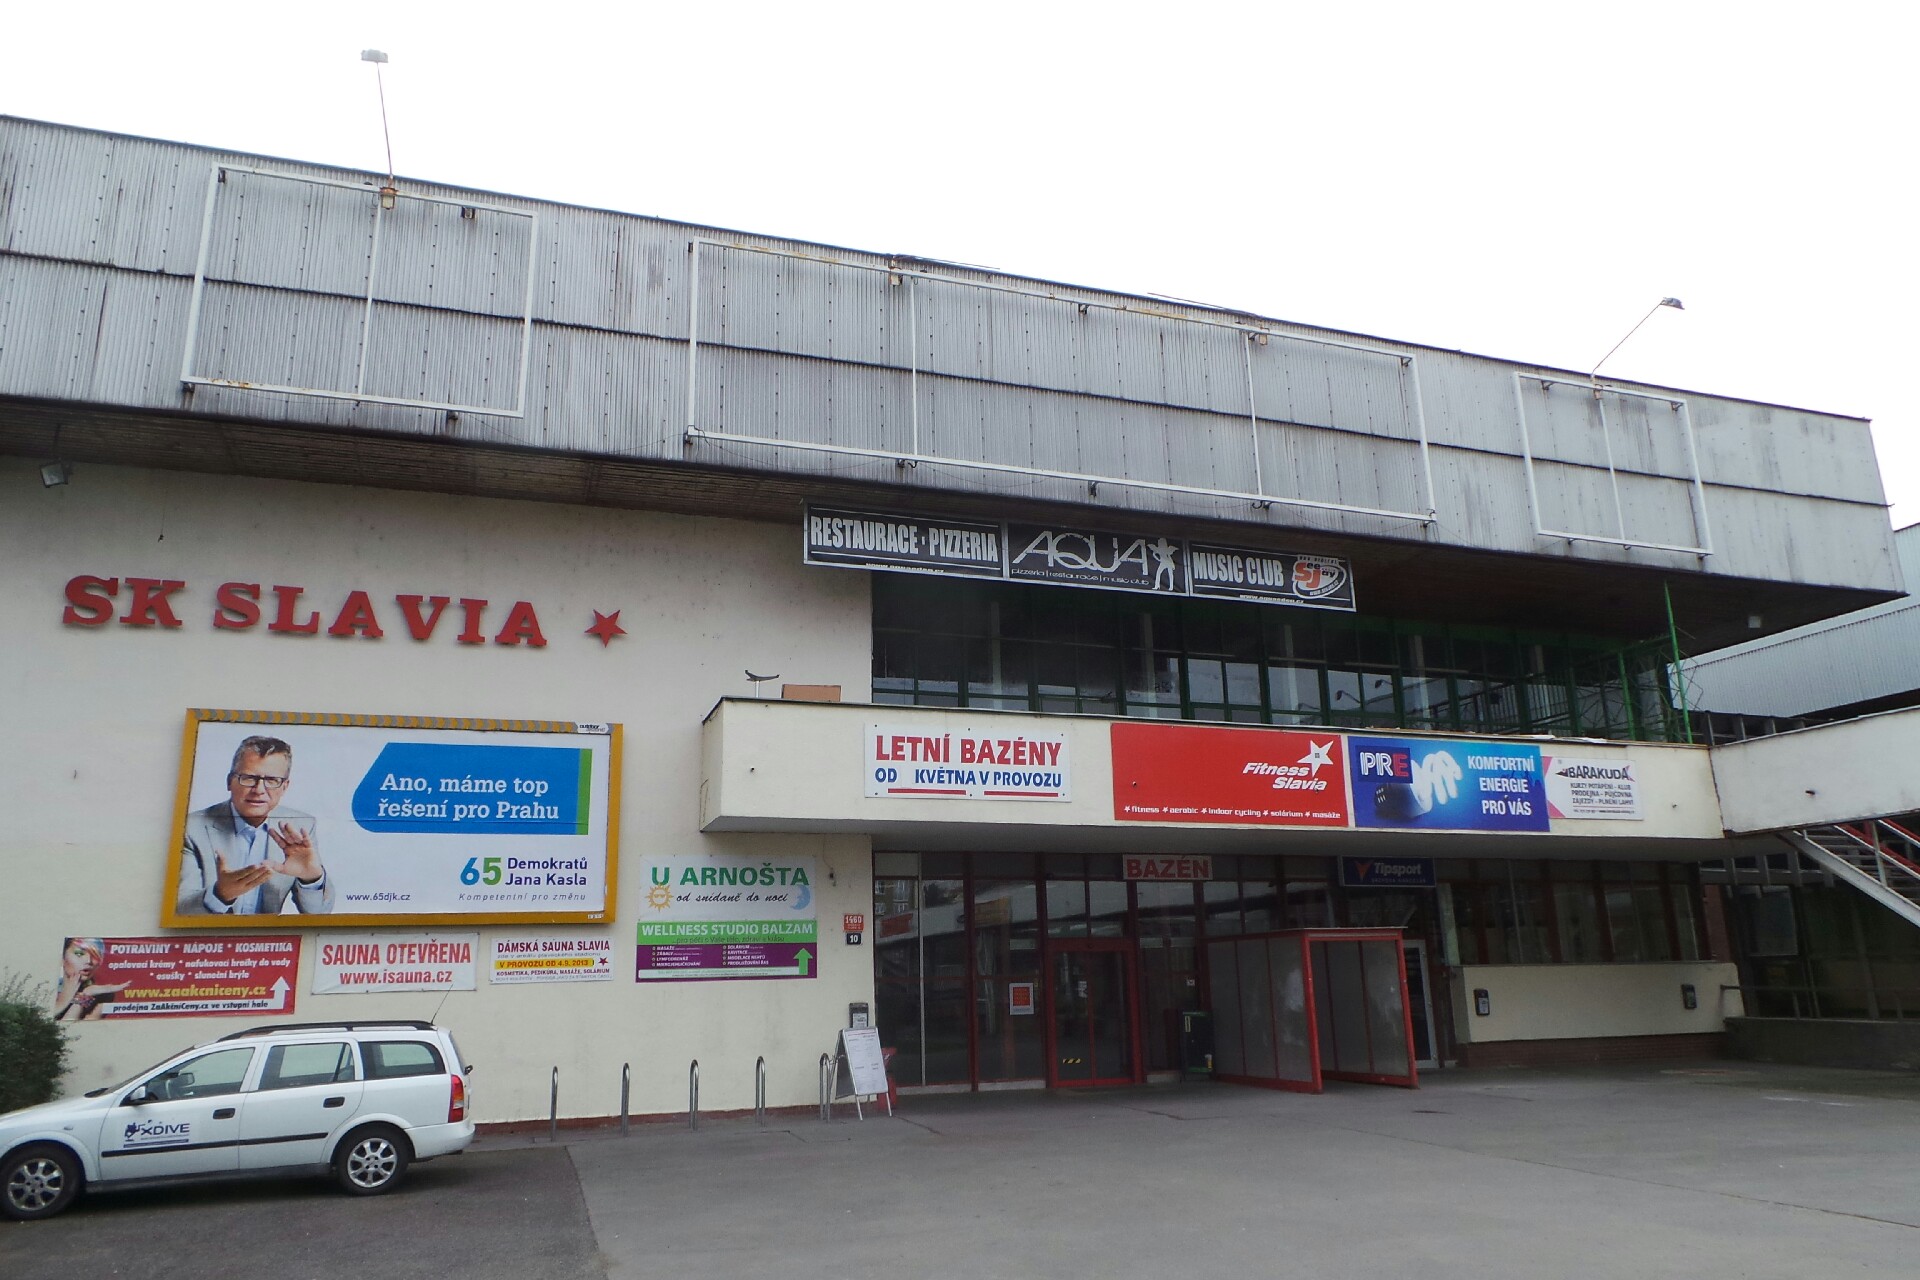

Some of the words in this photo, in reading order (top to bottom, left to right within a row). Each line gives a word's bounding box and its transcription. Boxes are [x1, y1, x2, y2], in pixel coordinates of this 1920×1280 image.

[811, 516, 919, 554] RESTAURACE
[929, 528, 998, 562] PIZZERIA
[1012, 531, 1148, 575] AQUA
[1011, 568, 1044, 576] pizzeria
[1050, 571, 1099, 580] restaurace
[1193, 552, 1243, 583] MUSIC
[1246, 557, 1284, 586] CLUB
[63, 575, 185, 626] SK
[213, 582, 547, 647] SLAVIA
[876, 733, 951, 763] LETNÍ
[960, 737, 1062, 766] BAZÉNY
[1242, 762, 1310, 776] Fitness
[1360, 752, 1409, 777] PRE
[1467, 755, 1535, 771] KOMFORTNÍ
[875, 767, 898, 783] OD
[915, 766, 976, 785] KVĚTNA
[979, 771, 989, 785] V
[994, 772, 1062, 787] PROVOZU
[1568, 765, 1630, 780] BARAKUDA
[380, 773, 433, 794] Ano,
[439, 774, 506, 794] máme
[514, 778, 549, 797] top
[1272, 777, 1328, 791] Slavia
[1479, 778, 1529, 793] ENERGIE
[378, 799, 447, 817] řešení
[453, 804, 490, 821] pro
[496, 801, 559, 819] Prahu
[1131, 805, 1159, 813] fitness
[1169, 806, 1198, 814] aerobic
[1234, 808, 1261, 817] cycling
[1270, 809, 1303, 817] solárium
[1312, 811, 1340, 819] masáže
[1482, 800, 1506, 815] PRO
[1508, 798, 1532, 816] VÁS
[460, 857, 502, 886] 65
[507, 856, 588, 870] Demokratů
[651, 867, 670, 885] U
[680, 863, 810, 885] ARNOŠTA
[1127, 856, 1209, 878] BAZÉN
[1374, 862, 1422, 877] Tipsport
[505, 873, 541, 886] Jana
[546, 873, 587, 886] Kasla
[346, 892, 411, 902] www.65djk.cz
[459, 893, 527, 902] Kompetentní
[552, 893, 586, 901] změnu
[676, 892, 691, 902] od
[696, 892, 742, 902] snídaně
[746, 892, 760, 901] do
[642, 925, 708, 936] WELLNESS
[711, 924, 758, 935] STUDIO
[762, 924, 813, 934] BALZAM
[498, 939, 538, 953] DÁMSKÁ
[542, 941, 574, 952] SAUNA
[577, 940, 610, 951] SLAVIA
[850, 935, 859, 943] 10
[110, 944, 170, 954] POTRAVINY
[183, 942, 223, 953] NÁPOJE
[235, 943, 292, 952] KOSMETIKA
[322, 944, 380, 965] SAUNA
[386, 939, 471, 964] OTEVŘENA
[108, 960, 148, 969] opalovací
[259, 958, 270, 966] do
[271, 958, 290, 967] vody
[156, 972, 185, 980] osušky
[228, 971, 249, 980] brýle
[340, 969, 452, 985] www.isauna.cz
[124, 984, 266, 998] www.zaakcniceny.cz
[113, 1004, 148, 1013] prodejna
[222, 1001, 250, 1010] vstupní
[251, 1000, 268, 1008] hale
